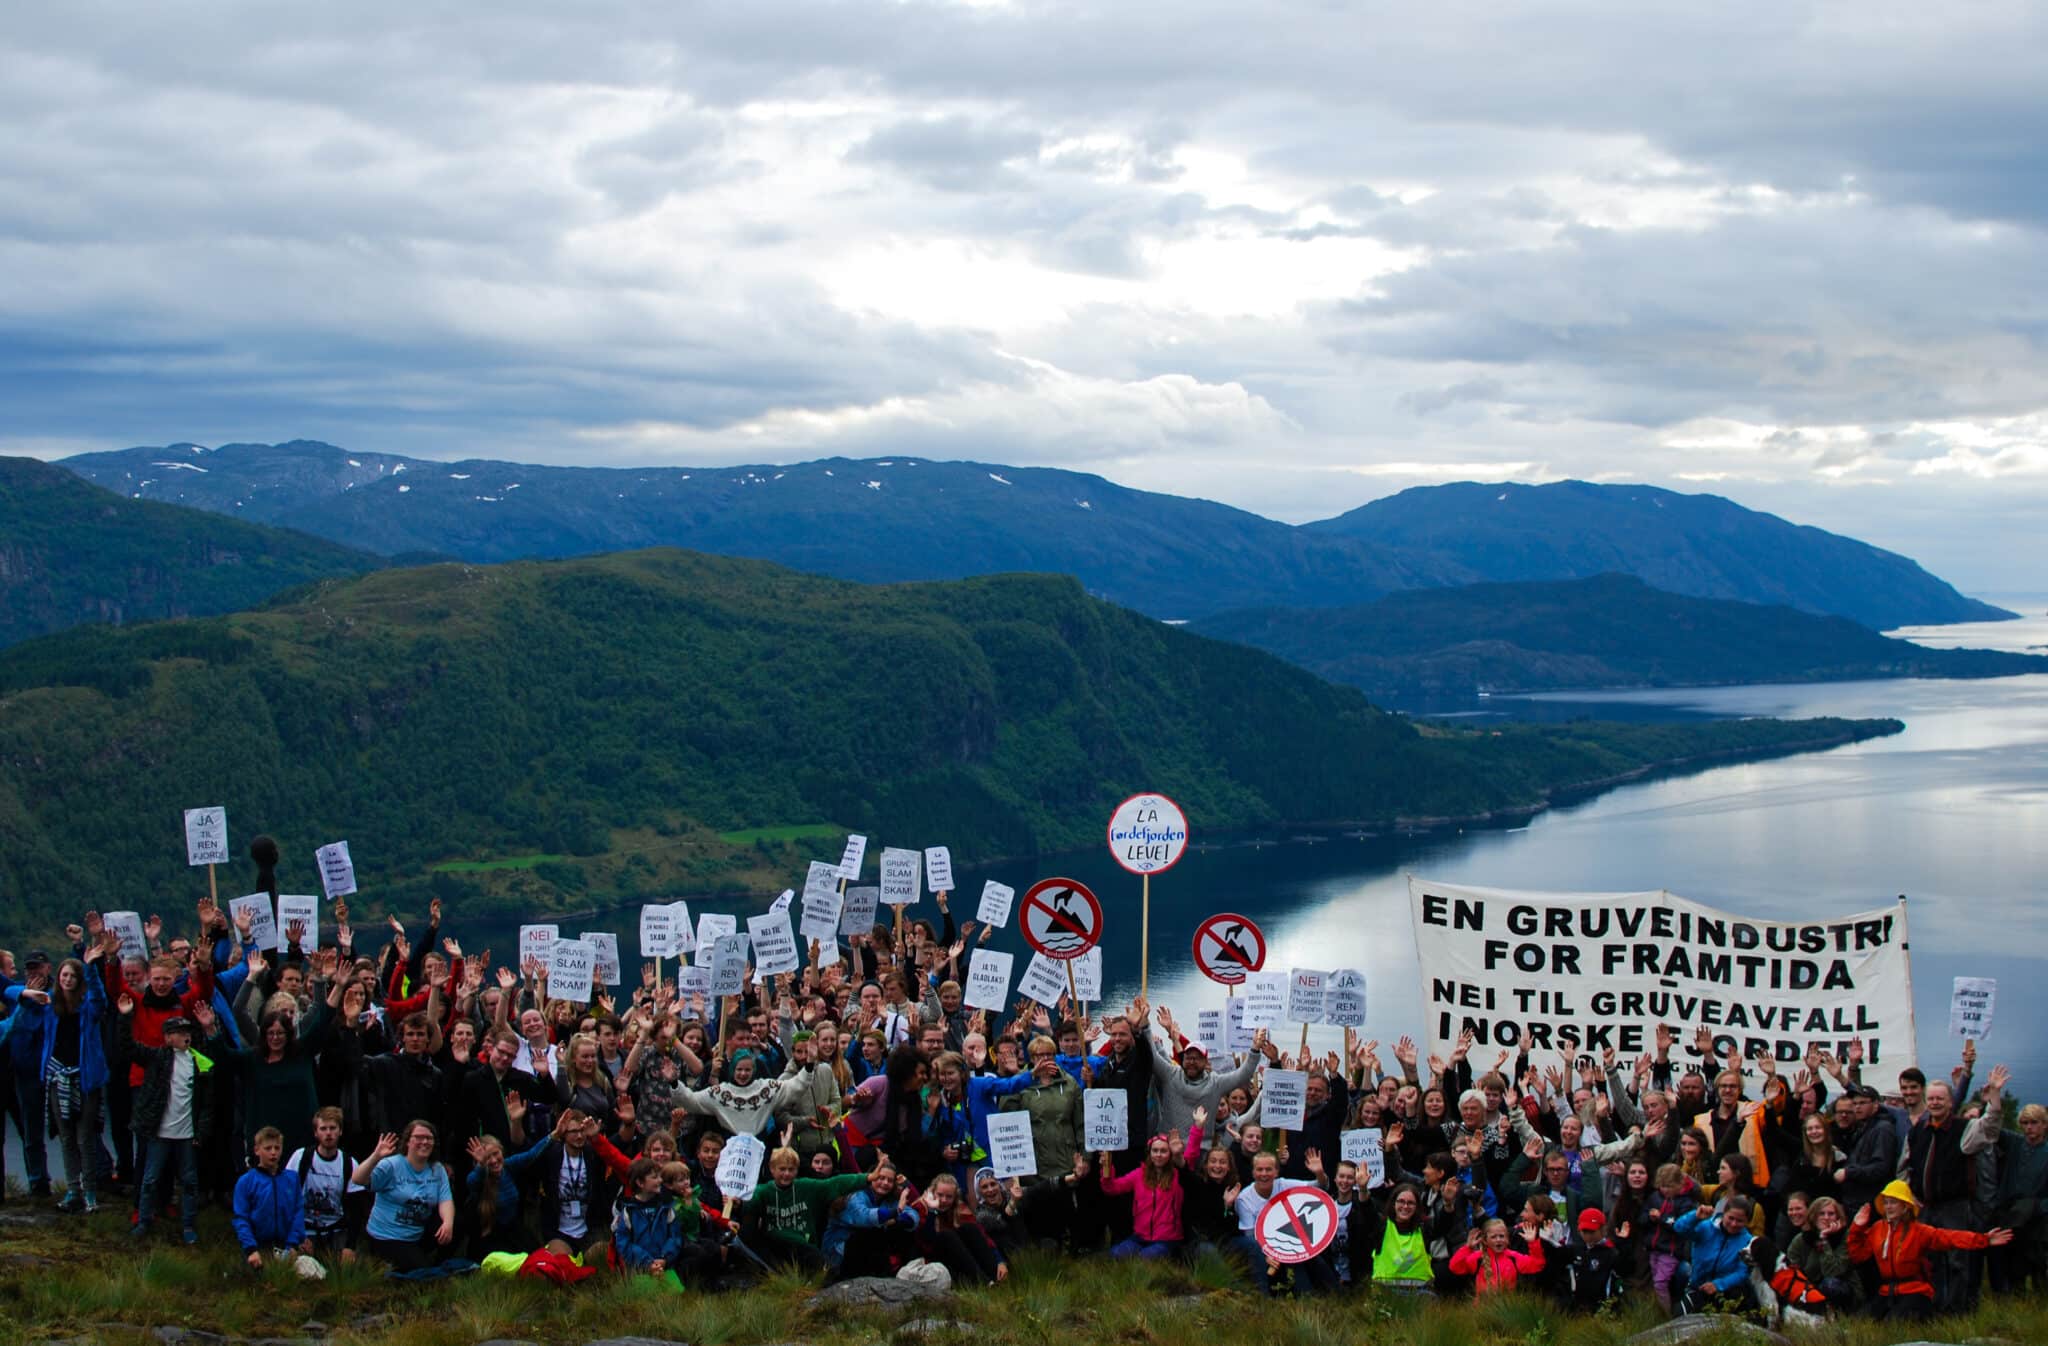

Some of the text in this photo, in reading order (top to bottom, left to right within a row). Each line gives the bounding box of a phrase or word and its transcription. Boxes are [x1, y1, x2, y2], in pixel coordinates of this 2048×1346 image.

[197, 815, 214, 826] JA
[1137, 809, 1158, 823] LA
[200, 831, 211, 839] TIL
[197, 841, 218, 850] REN
[1128, 844, 1169, 864] LEVE!
[886, 869, 912, 878] SLAM
[884, 886, 913, 896] SKAM!
[1423, 894, 1893, 954] EN GRUVEINDUSTRI
[529, 931, 550, 941] NEI
[725, 940, 739, 953] JA
[556, 958, 587, 970] SLAM
[1484, 939, 1855, 990] FOR FRAMTIDA
[720, 969, 738, 979] REN
[973, 972, 1005, 984] GLADLAKS!
[552, 979, 587, 991] SKAM!
[1075, 978, 1092, 986] REN
[1298, 975, 1320, 987] NEI
[1337, 976, 1355, 988] JA
[1336, 1002, 1357, 1012] REN
[1433, 977, 1880, 1032] NEI TIL GRUVEAVFALL
[1439, 1011, 1451, 1040] I
[1462, 1016, 1643, 1053] NORSKE
[1097, 1097, 1114, 1110] JA
[1100, 1115, 1111, 1123] TIL
[1095, 1125, 1117, 1134] REN
[1089, 1136, 1123, 1146] FJORD!
[1347, 1148, 1377, 1159] SLAM
